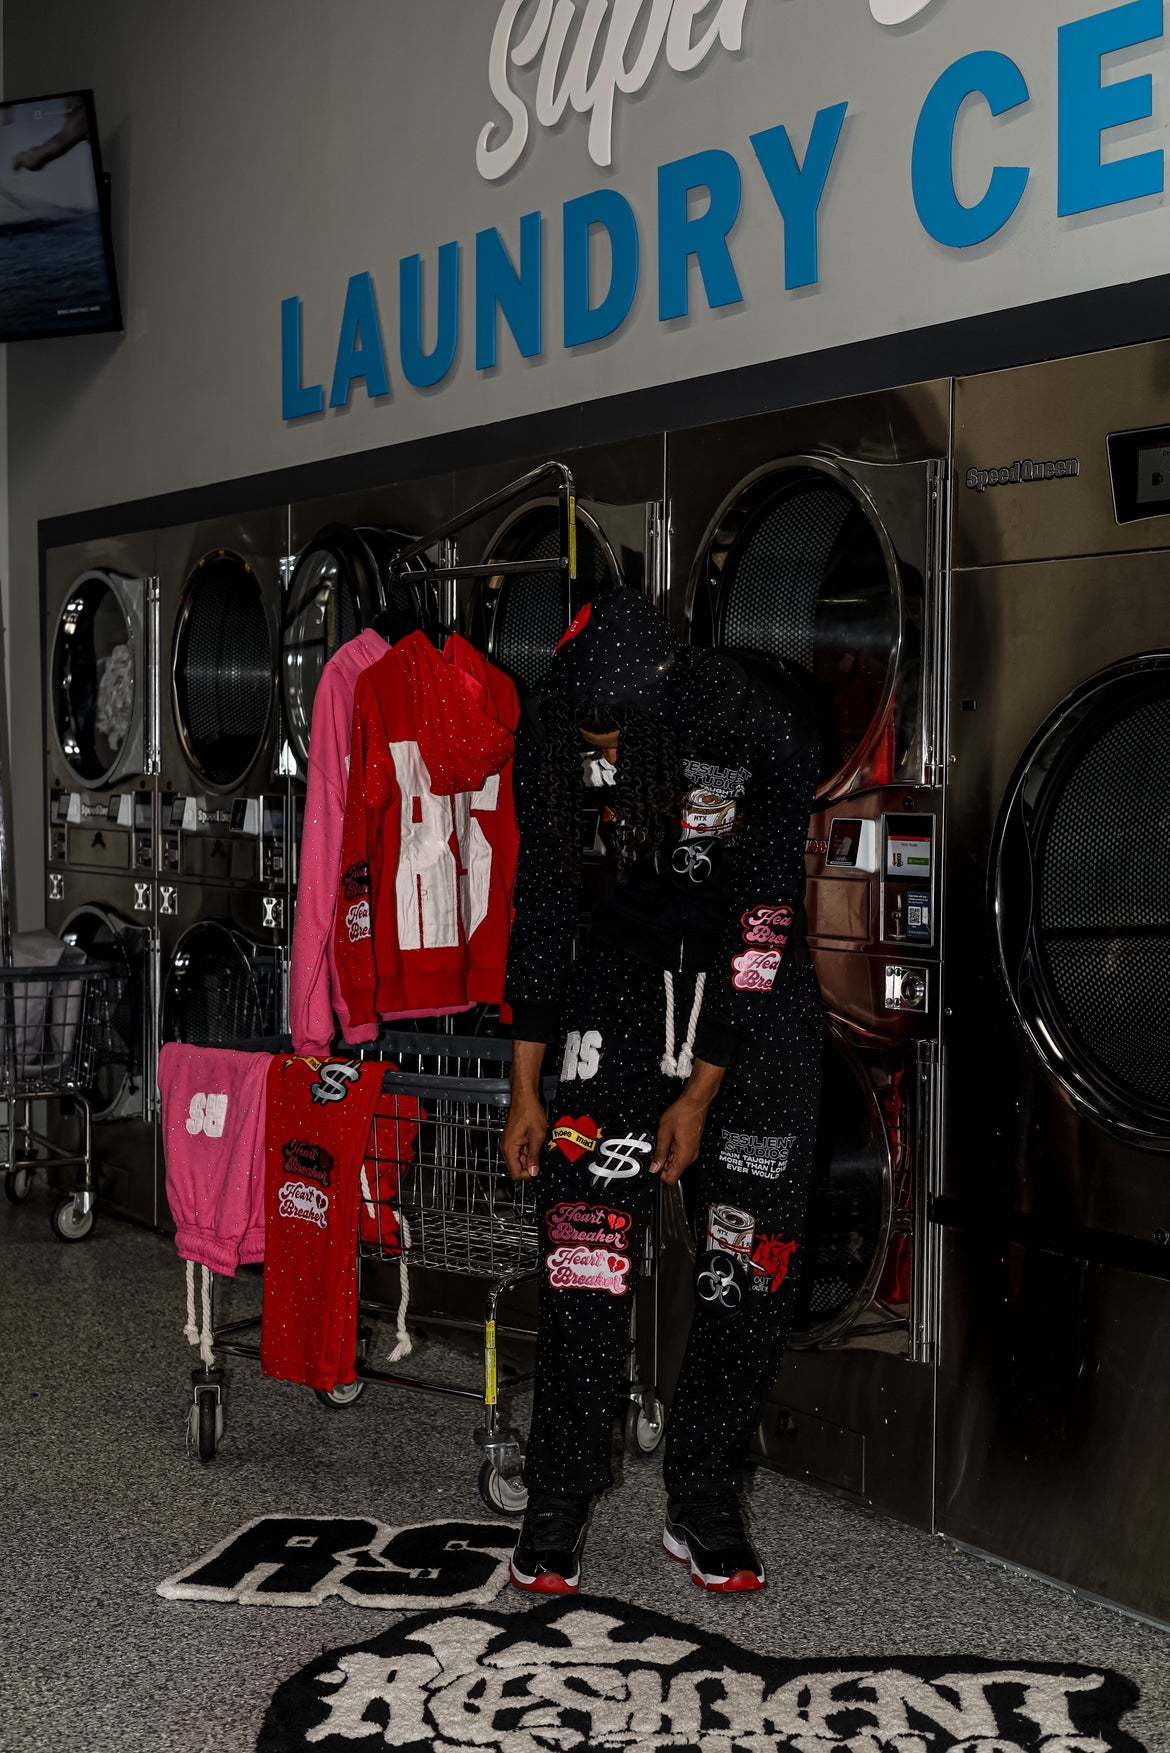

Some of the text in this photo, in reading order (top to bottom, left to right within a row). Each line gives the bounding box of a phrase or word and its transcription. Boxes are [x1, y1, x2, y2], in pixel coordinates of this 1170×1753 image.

[282, 102, 848, 421] LAUNDRY
[966, 458, 1080, 493] Speed Queen
[726, 1163, 749, 1175] EVER
[742, 1154, 777, 1167] TAUGHT
[745, 1161, 769, 1172] THAN
[280, 1184, 315, 1202] Heart
[280, 1199, 326, 1228] Breaker
[551, 1205, 606, 1225] Heart
[551, 1222, 625, 1249] Breaker
[551, 1247, 605, 1268] Heart
